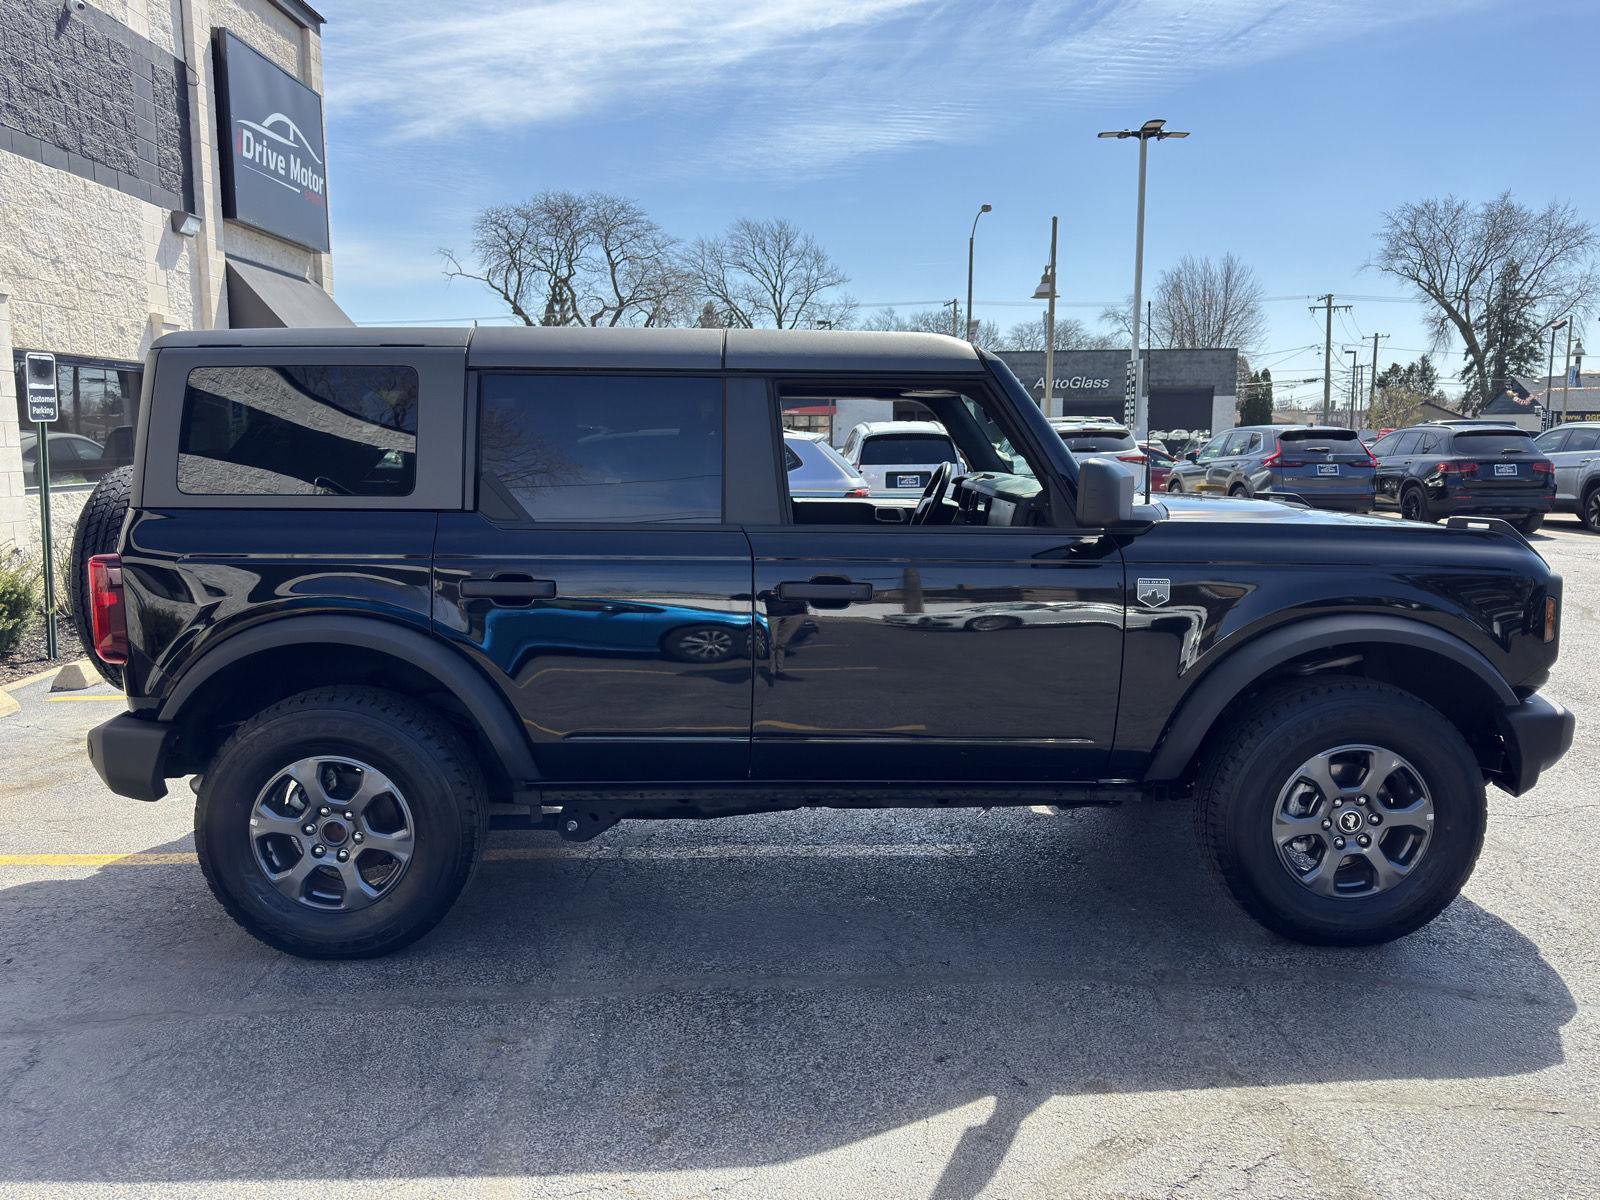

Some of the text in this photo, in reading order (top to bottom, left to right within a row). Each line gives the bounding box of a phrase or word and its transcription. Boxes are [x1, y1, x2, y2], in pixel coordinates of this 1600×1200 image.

[290, 153, 324, 195] Motor
[29, 394, 56, 403] Customer
[32, 406, 54, 416] Parking
